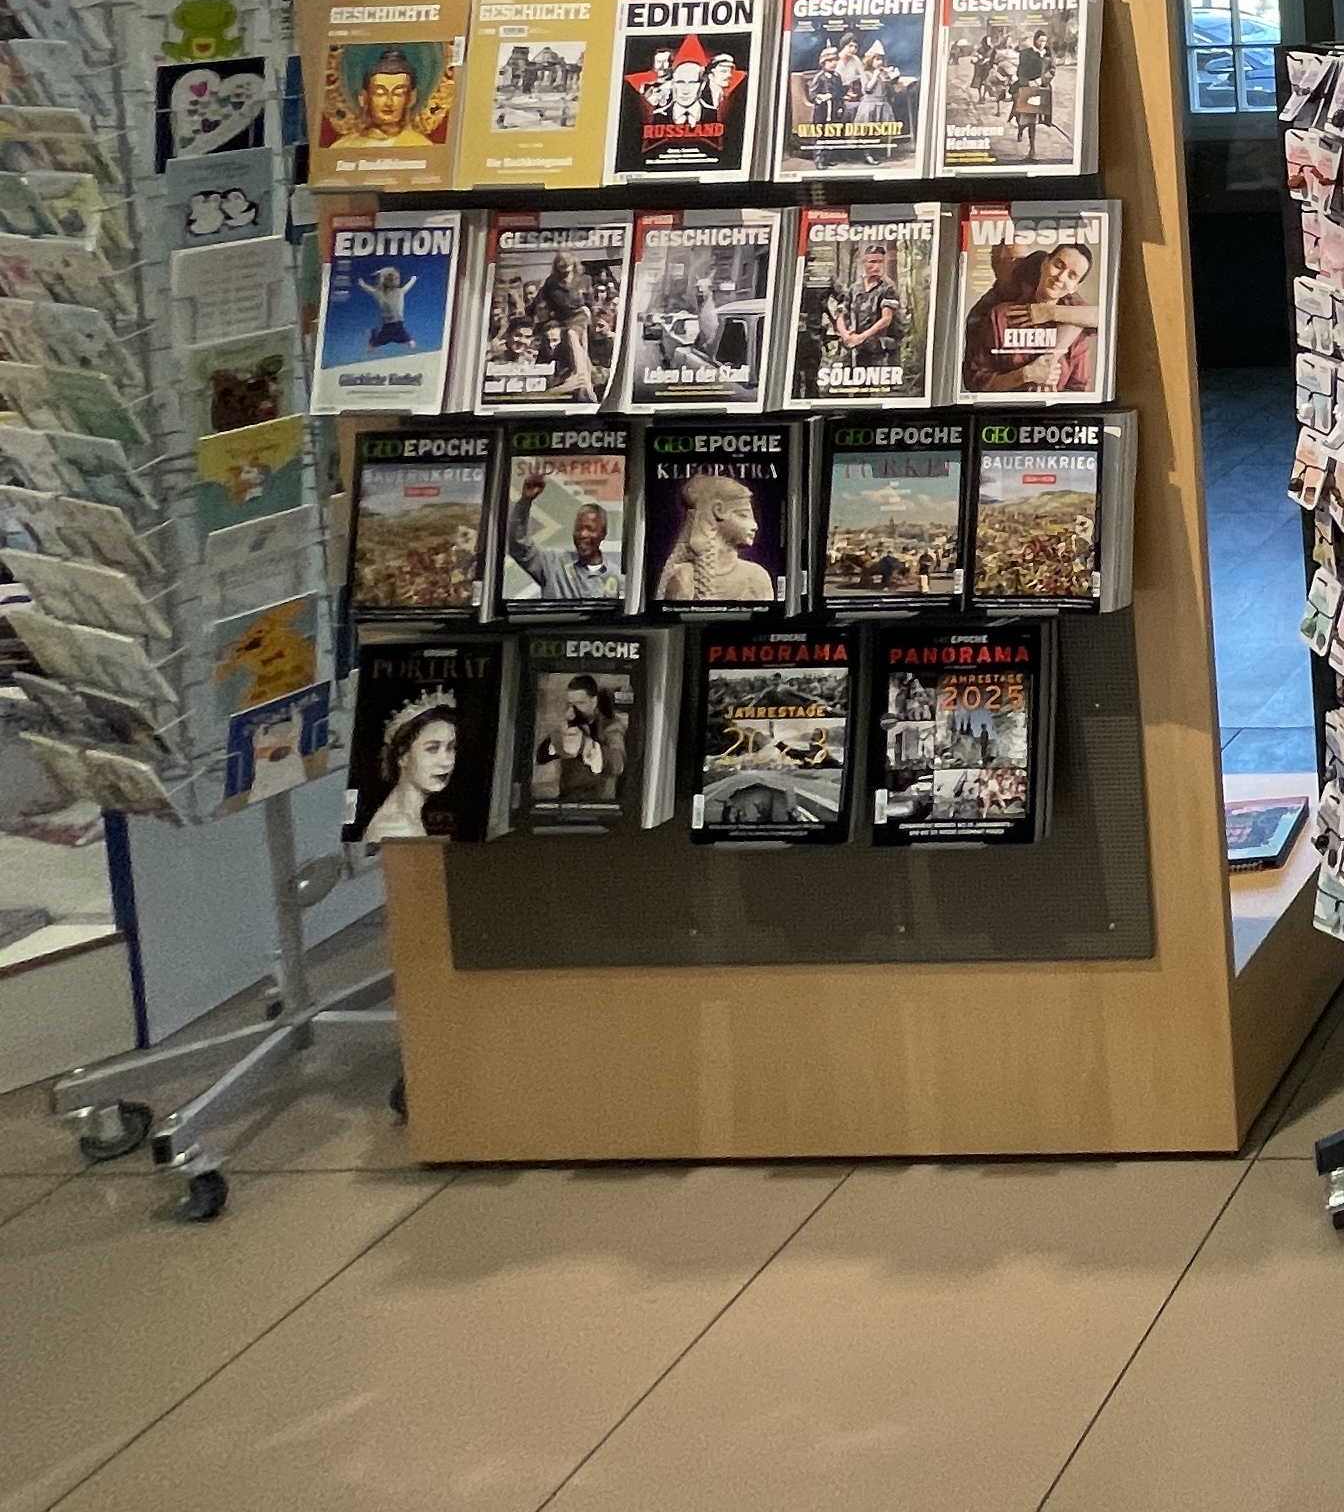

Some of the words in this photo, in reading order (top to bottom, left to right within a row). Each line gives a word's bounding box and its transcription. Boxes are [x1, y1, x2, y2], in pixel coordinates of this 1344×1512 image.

[329, 4, 440, 24] GESCHICHTE
[479, 3, 591, 22] GESCHICHTE
[626, 0, 754, 28] EDITION
[643, 122, 725, 140] RUSSLAND
[798, 123, 823, 138] WAS
[825, 122, 842, 137] IST
[946, 136, 990, 150] Heimat
[499, 229, 623, 249] GESCHICHTE
[645, 225, 770, 248] GESCHICHTE
[809, 223, 933, 243] GESCHICHTE
[971, 219, 1100, 245] WISSEN
[334, 229, 452, 256] EDITION
[1003, 328, 1057, 348] ELTERN
[817, 363, 904, 386] SÖLDNER
[551, 431, 627, 449] EPOCHE
[694, 434, 782, 453] EPOCHE
[875, 426, 963, 445] EPOCHE
[982, 426, 1017, 444] GEO
[1019, 425, 1099, 444] EPOCHE
[403, 438, 490, 457] EPOCHE
[982, 455, 1096, 471] BAUERNKRIEG
[566, 641, 640, 659] EPOCHE
[708, 644, 848, 662] PANORAMA
[889, 645, 1029, 665] PANORAMA
[940, 686, 1025, 711] 2025
[724, 704, 826, 719] JAHRESTAGE
